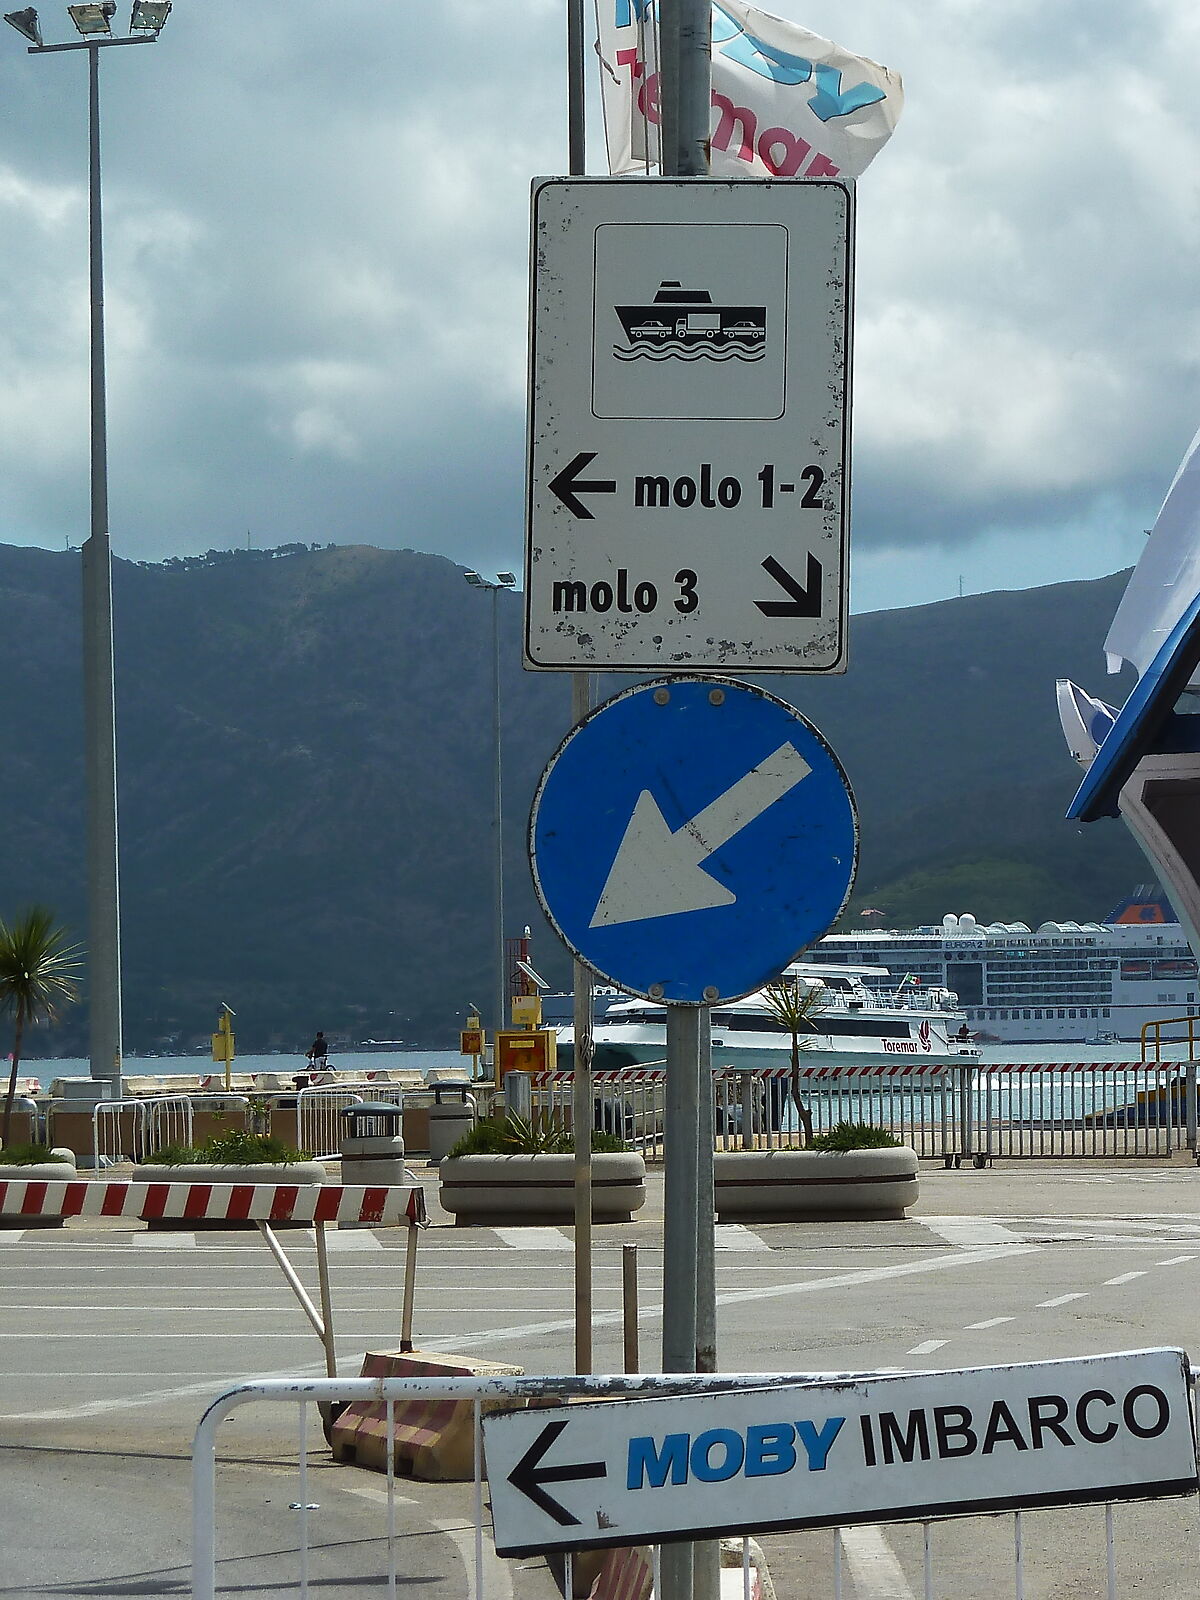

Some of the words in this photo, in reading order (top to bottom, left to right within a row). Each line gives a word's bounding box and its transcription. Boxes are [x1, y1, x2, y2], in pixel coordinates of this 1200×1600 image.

[634, 463, 741, 508] molo
[758, 464, 824, 508] 1-2
[552, 569, 658, 613] molo
[673, 569, 698, 613] 3
[945, 941, 976, 949] EUROPA
[881, 1039, 917, 1052] Toremar
[626, 1416, 845, 1490] MOBY
[859, 1384, 1170, 1467] IMBARCO
